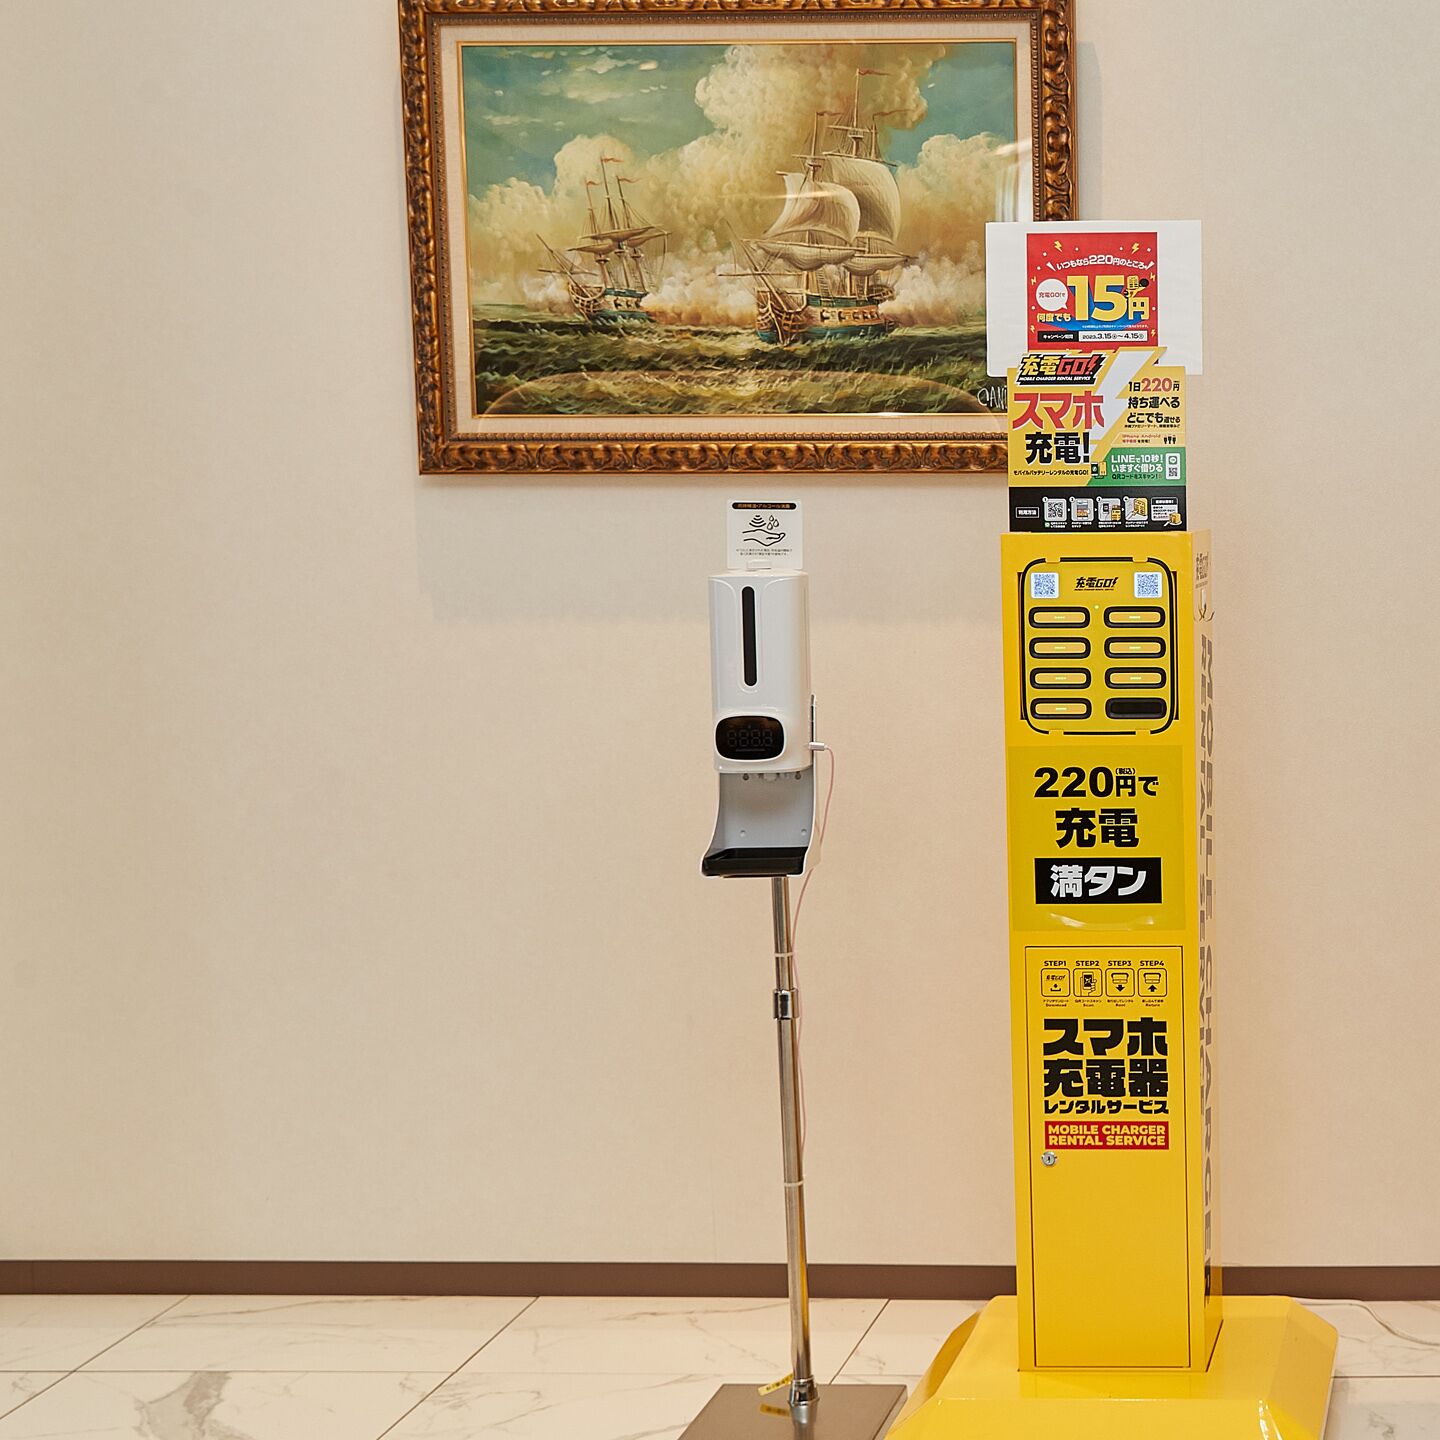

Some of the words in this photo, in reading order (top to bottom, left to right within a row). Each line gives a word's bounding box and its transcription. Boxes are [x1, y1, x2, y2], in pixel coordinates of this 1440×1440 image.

[1021, 354, 1099, 376] 充電GO!
[1012, 390, 1104, 429] スマホ
[1128, 396, 1180, 409] 持ち運べる
[1025, 431, 1090, 465] 充電!
[1075, 577, 1119, 588] 充電GO!
[1034, 766, 1159, 798] 220円で
[1205, 640, 1213, 921] MOBILE
[1055, 807, 1139, 848] 充電
[1050, 864, 1147, 898] 満タン
[1043, 1017, 1168, 1056] スマホ
[1043, 1058, 1169, 1098] 充電器
[1044, 1099, 1169, 1115] レンタルサービス
[1048, 1124, 1099, 1135] MOBILE
[1101, 1124, 1166, 1135] CHARGER
[1048, 1135, 1103, 1146] RENTAL
[1106, 1135, 1166, 1146] SERVICE
